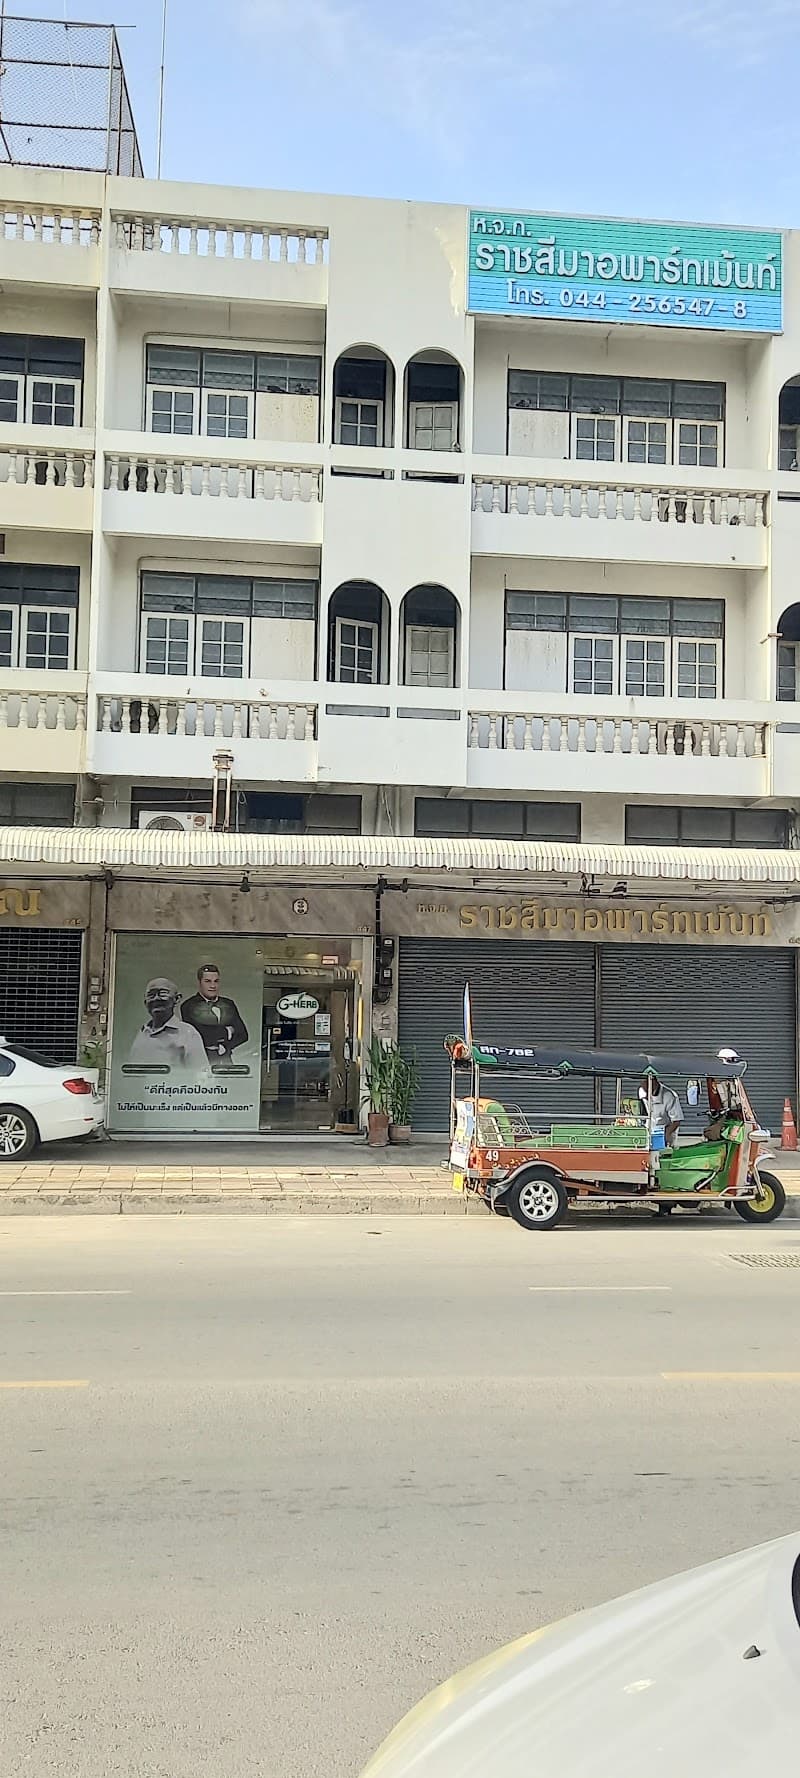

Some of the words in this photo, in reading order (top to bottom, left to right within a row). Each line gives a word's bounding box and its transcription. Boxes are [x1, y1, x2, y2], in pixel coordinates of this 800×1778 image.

[473, 217, 532, 237] ห.จ.ก.
[475, 237, 776, 289] ราชสีมาอพาร์ทเม้นท์
[507, 278, 550, 305] โทร.
[459, 898, 773, 936] ราชสีมาอพาร์ทเม้นท์
[278, 996, 318, 1010] G-HERB
[485, 1150, 499, 1162] 49
